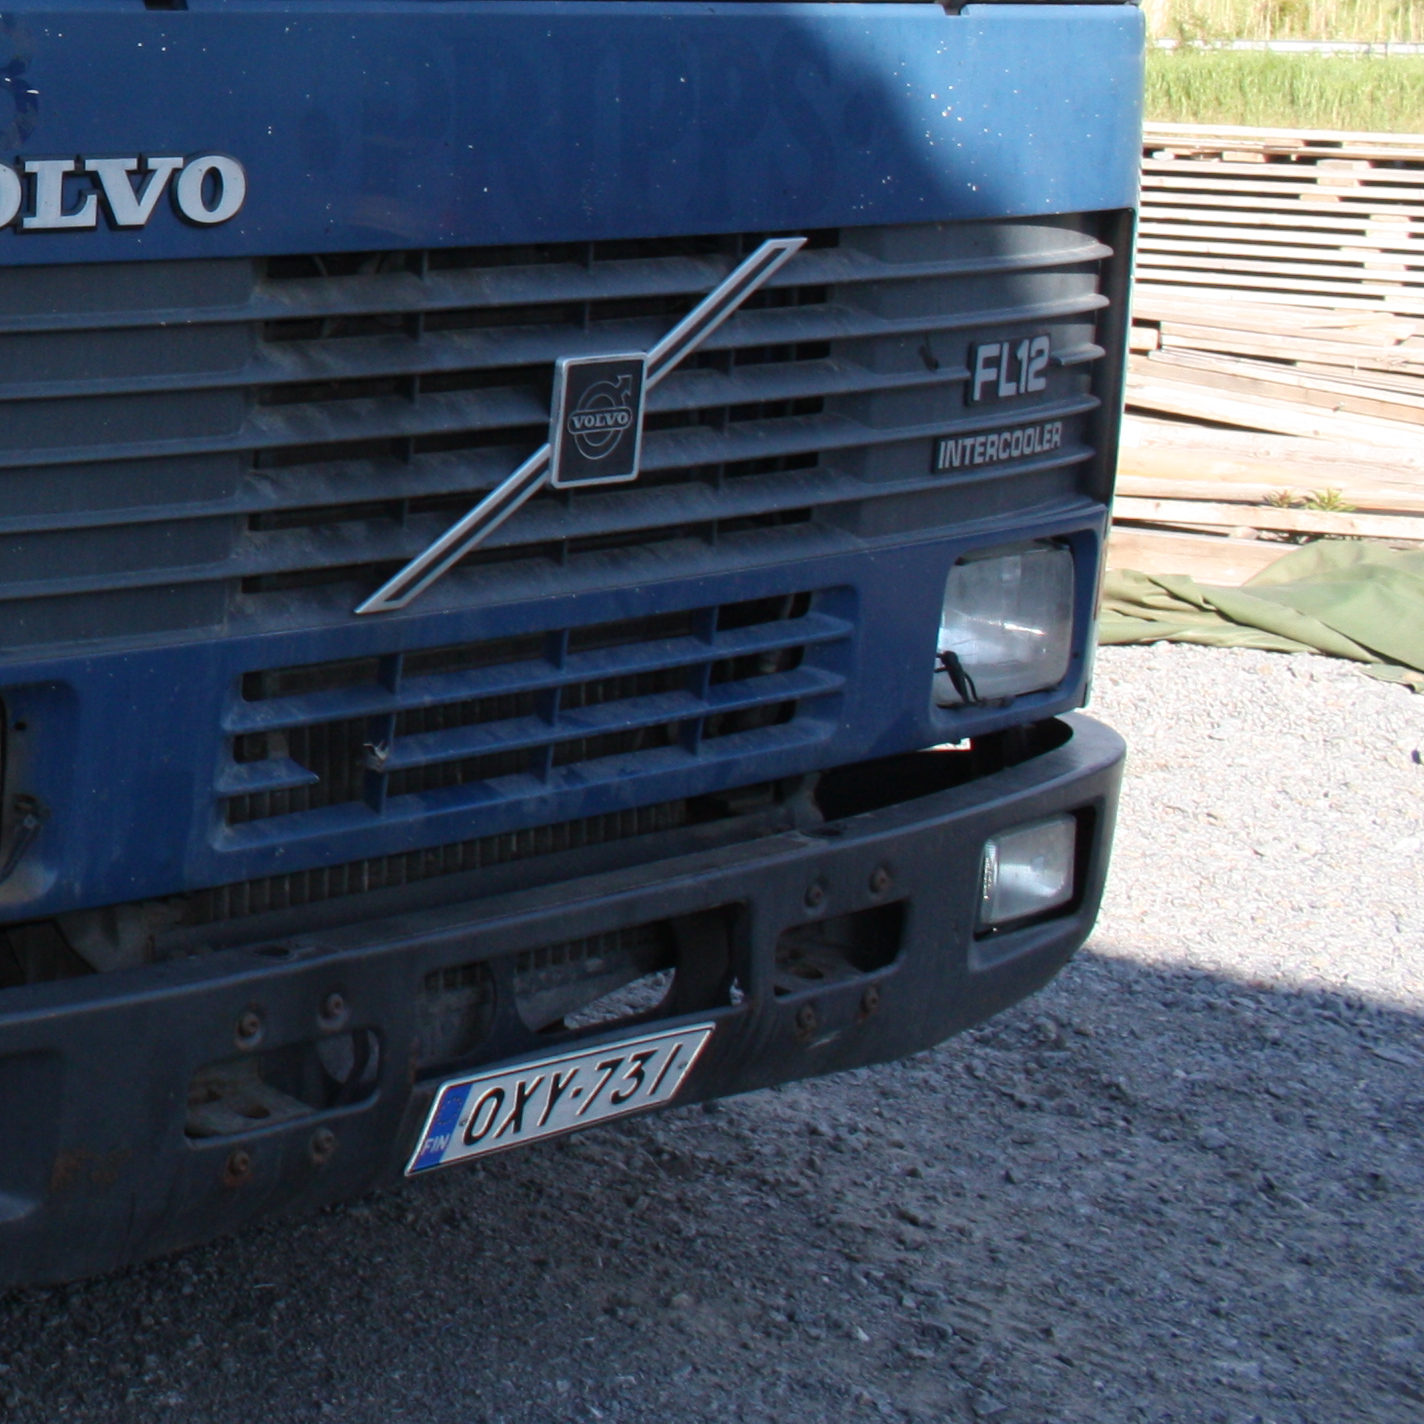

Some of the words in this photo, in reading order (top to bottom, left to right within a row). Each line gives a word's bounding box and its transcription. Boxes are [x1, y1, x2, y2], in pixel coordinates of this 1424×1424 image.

[972, 335, 1051, 402] FL12
[572, 411, 629, 430] VOLVO
[937, 421, 1063, 470] INTERCOOLER
[461, 1042, 684, 1147] OXY-731
[419, 1132, 452, 1156] FIN
